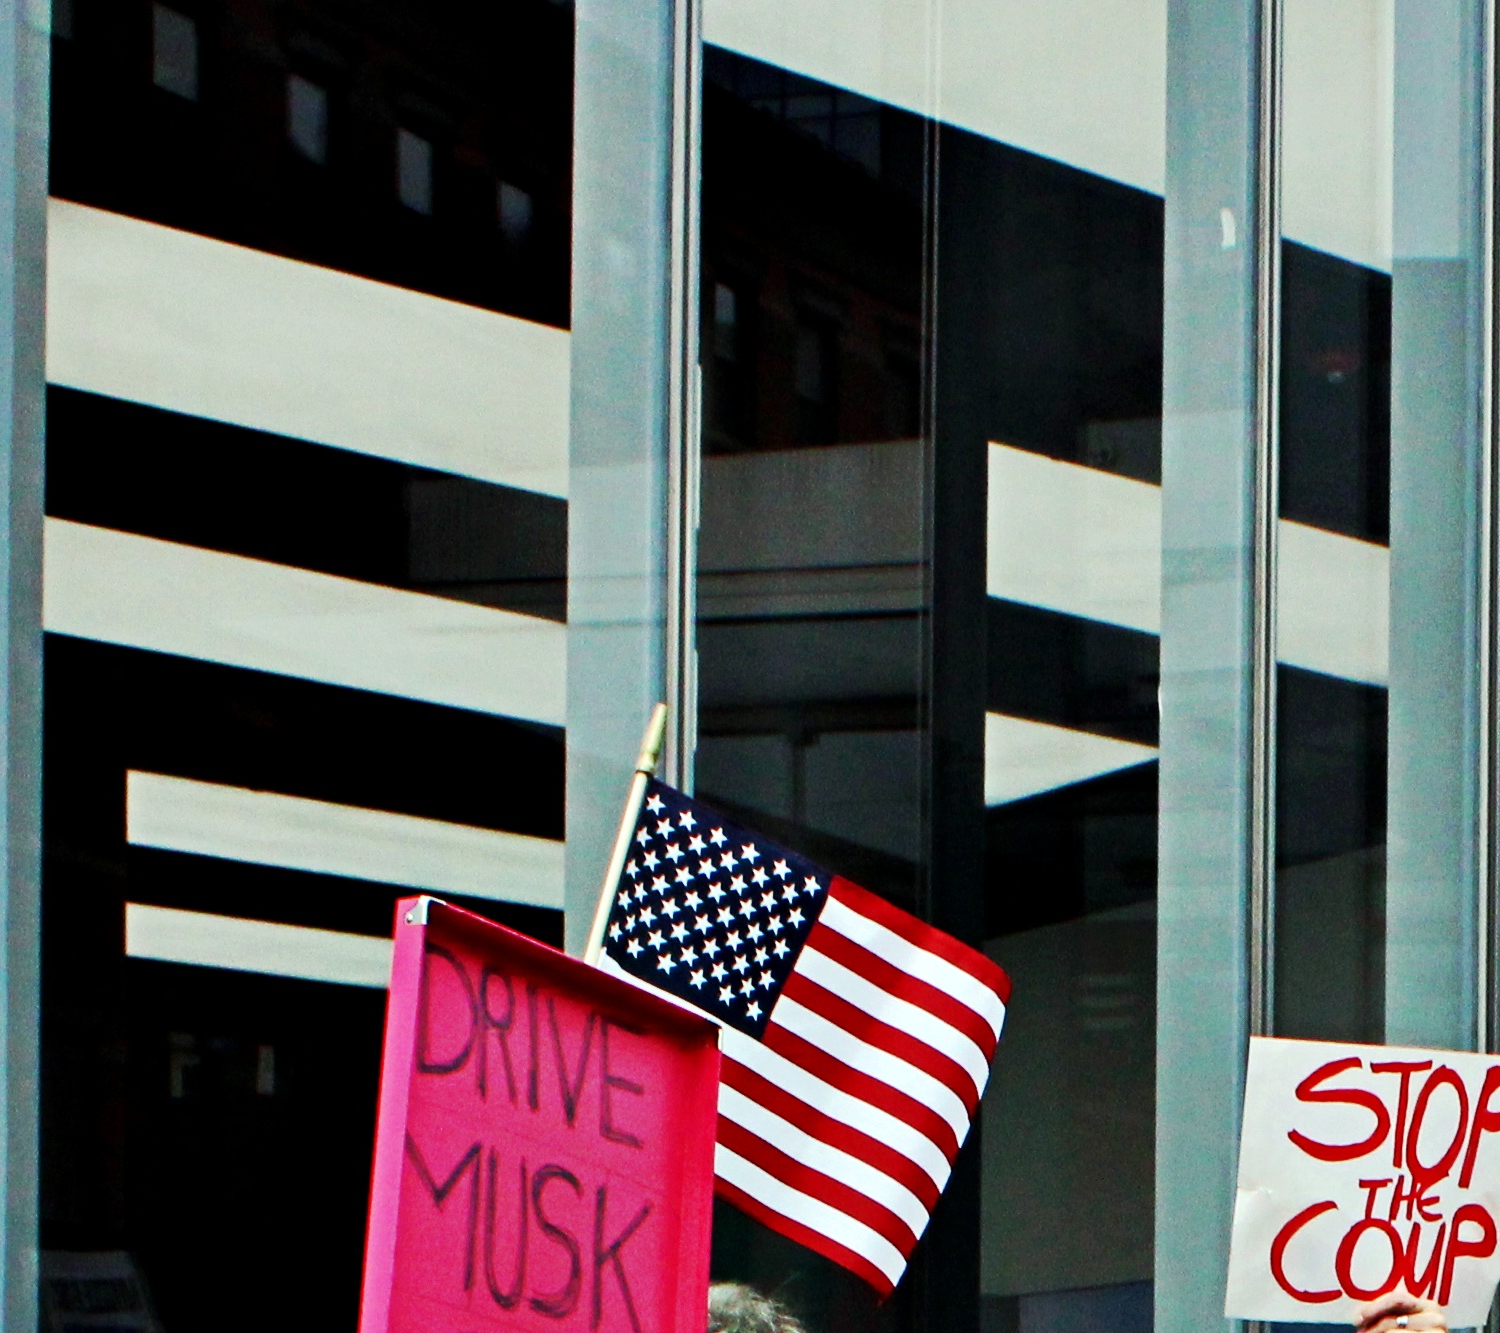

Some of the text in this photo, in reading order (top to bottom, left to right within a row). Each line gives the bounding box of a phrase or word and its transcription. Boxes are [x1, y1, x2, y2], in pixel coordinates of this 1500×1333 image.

[414, 943, 648, 1150] DRIVE
[1359, 1173, 1444, 1223] THE
[1270, 1200, 1498, 1306] COUP
